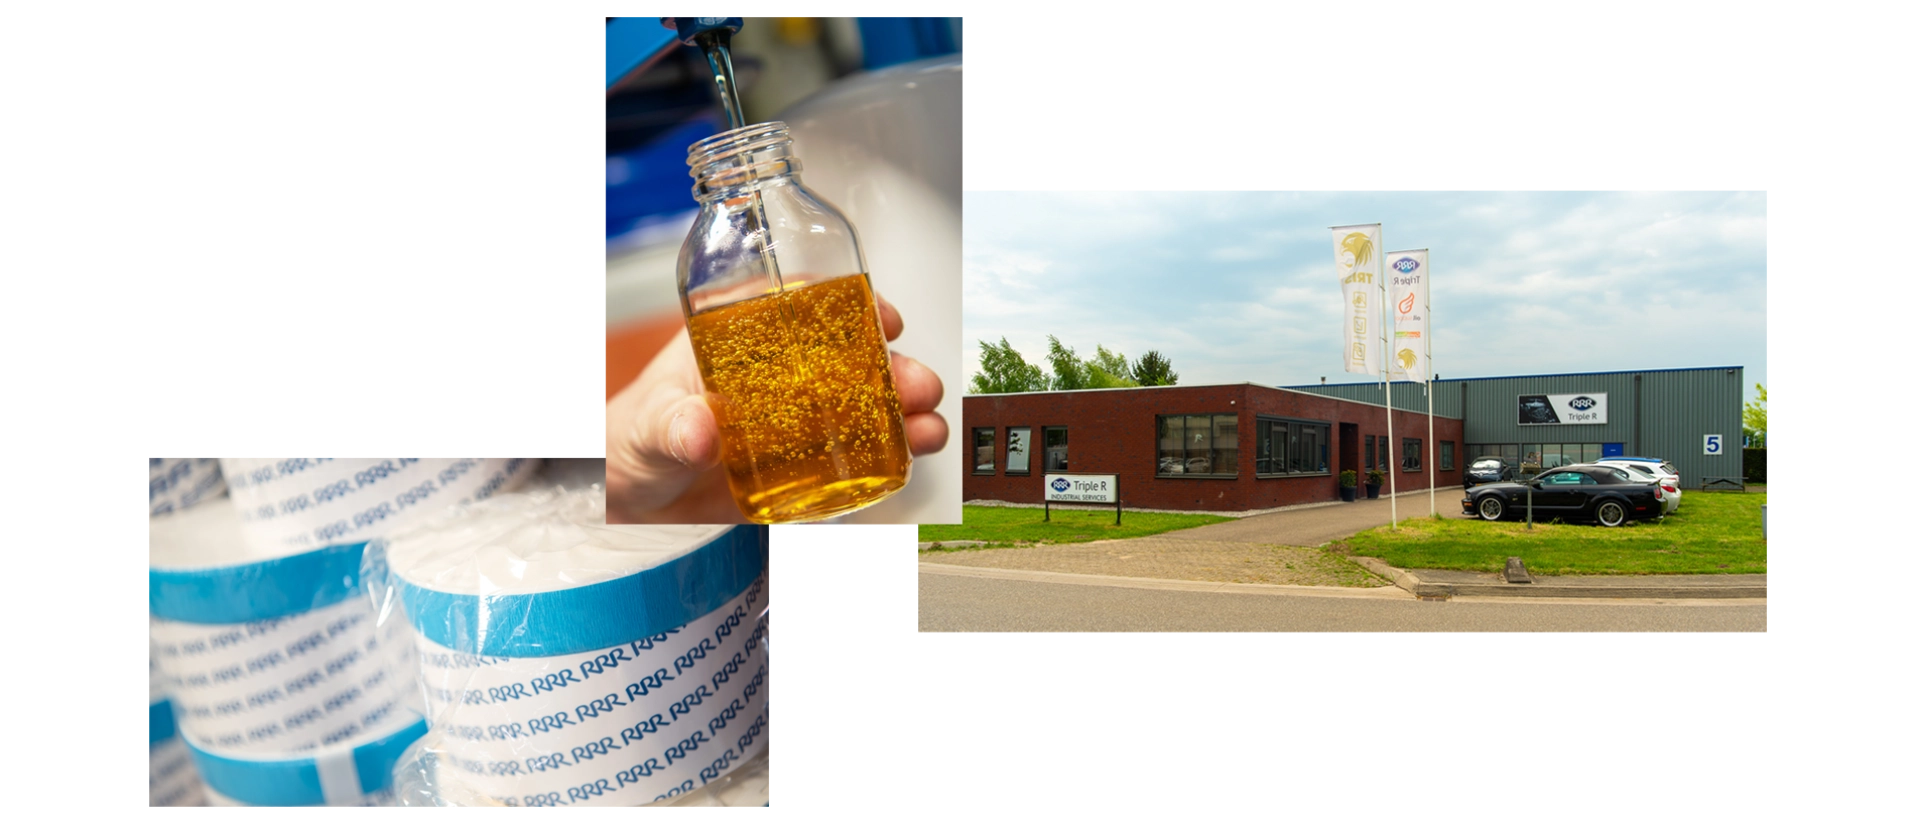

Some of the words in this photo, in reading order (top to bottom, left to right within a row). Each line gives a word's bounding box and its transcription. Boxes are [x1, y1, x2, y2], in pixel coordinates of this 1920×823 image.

[1568, 413, 1590, 422] Triple
[1591, 412, 1598, 420] R
[1572, 398, 1594, 408] RRR
[1706, 436, 1720, 453] 5
[1053, 480, 1069, 489] RRR
[1074, 481, 1099, 492] Triple
[1101, 481, 1107, 491] R
[488, 682, 533, 703] RRR
[530, 668, 582, 695] RRR
[579, 648, 633, 680] RRR
[528, 711, 577, 736] RRR
[575, 693, 628, 723] RRR
[625, 667, 676, 702] RRR
[673, 637, 718, 676] RRR
[714, 604, 748, 645] RRR
[525, 752, 573, 774] RRR
[570, 736, 623, 764] RRR
[620, 713, 671, 746] RRR
[668, 684, 714, 721] RRR
[711, 652, 747, 691] RRR
[566, 778, 617, 803] RRR
[615, 757, 667, 788] RRR
[664, 730, 711, 766] RRR
[707, 698, 746, 737] RRR
[699, 748, 740, 785] RRR
